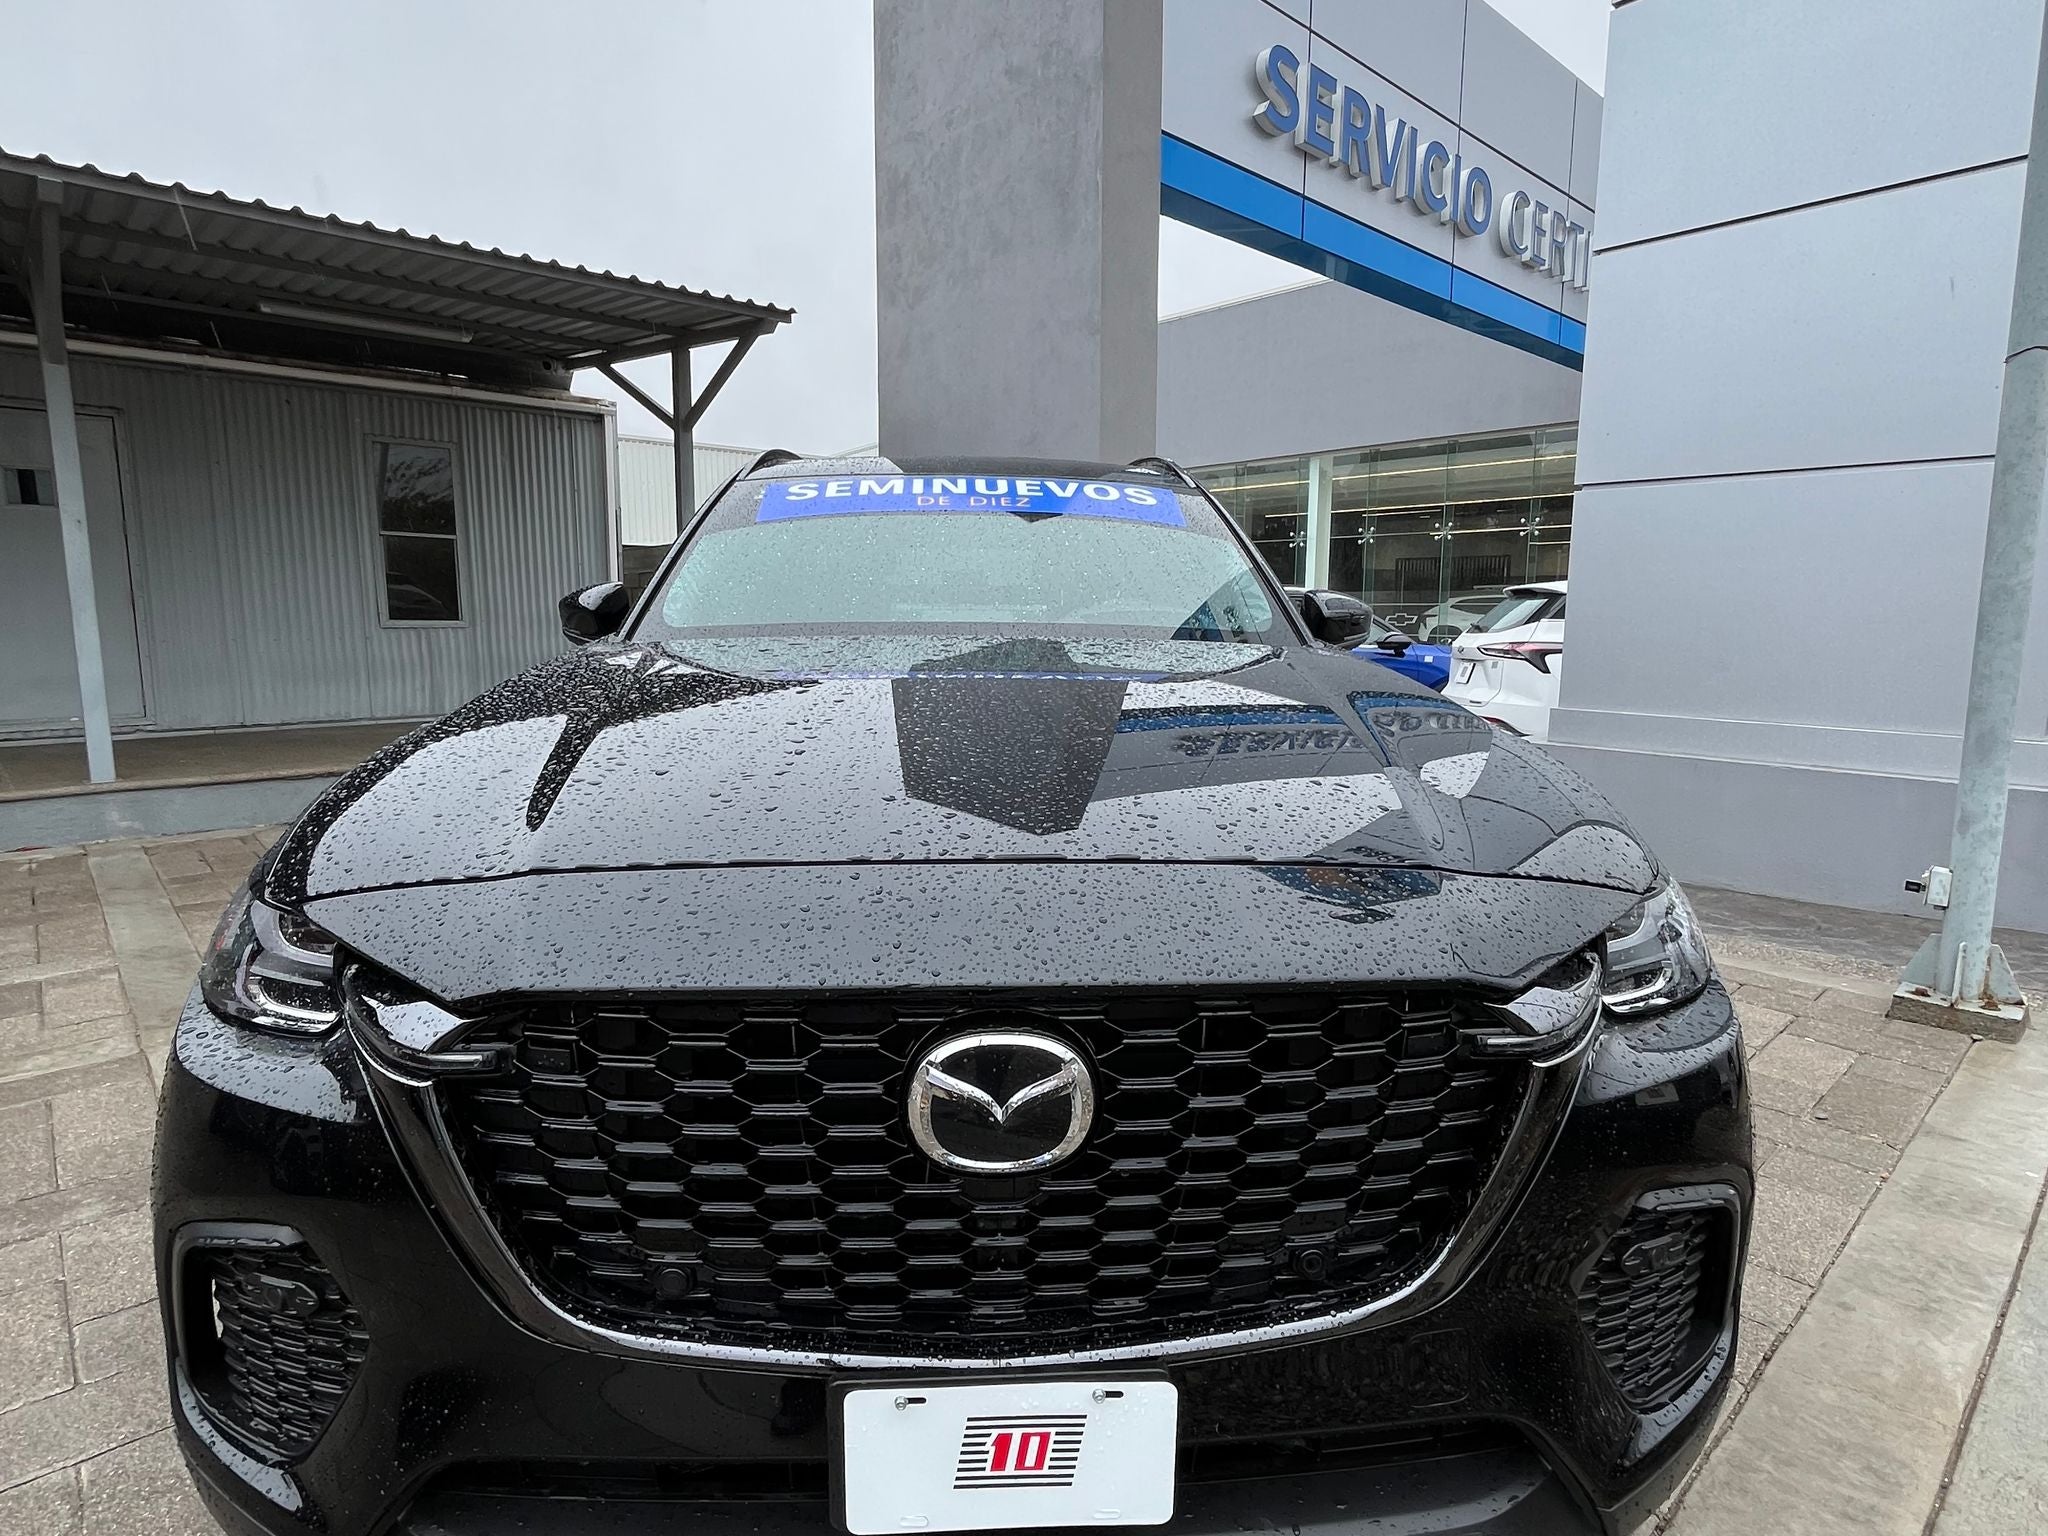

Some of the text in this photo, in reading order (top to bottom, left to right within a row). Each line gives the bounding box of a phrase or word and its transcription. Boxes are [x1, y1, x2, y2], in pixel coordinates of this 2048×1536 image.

[1253, 44, 1592, 292] SERVICIO CERTI
[785, 477, 1158, 506] SEMINUEVOS
[917, 496, 1032, 508] DE DIEZ
[990, 1431, 1052, 1472] 10
